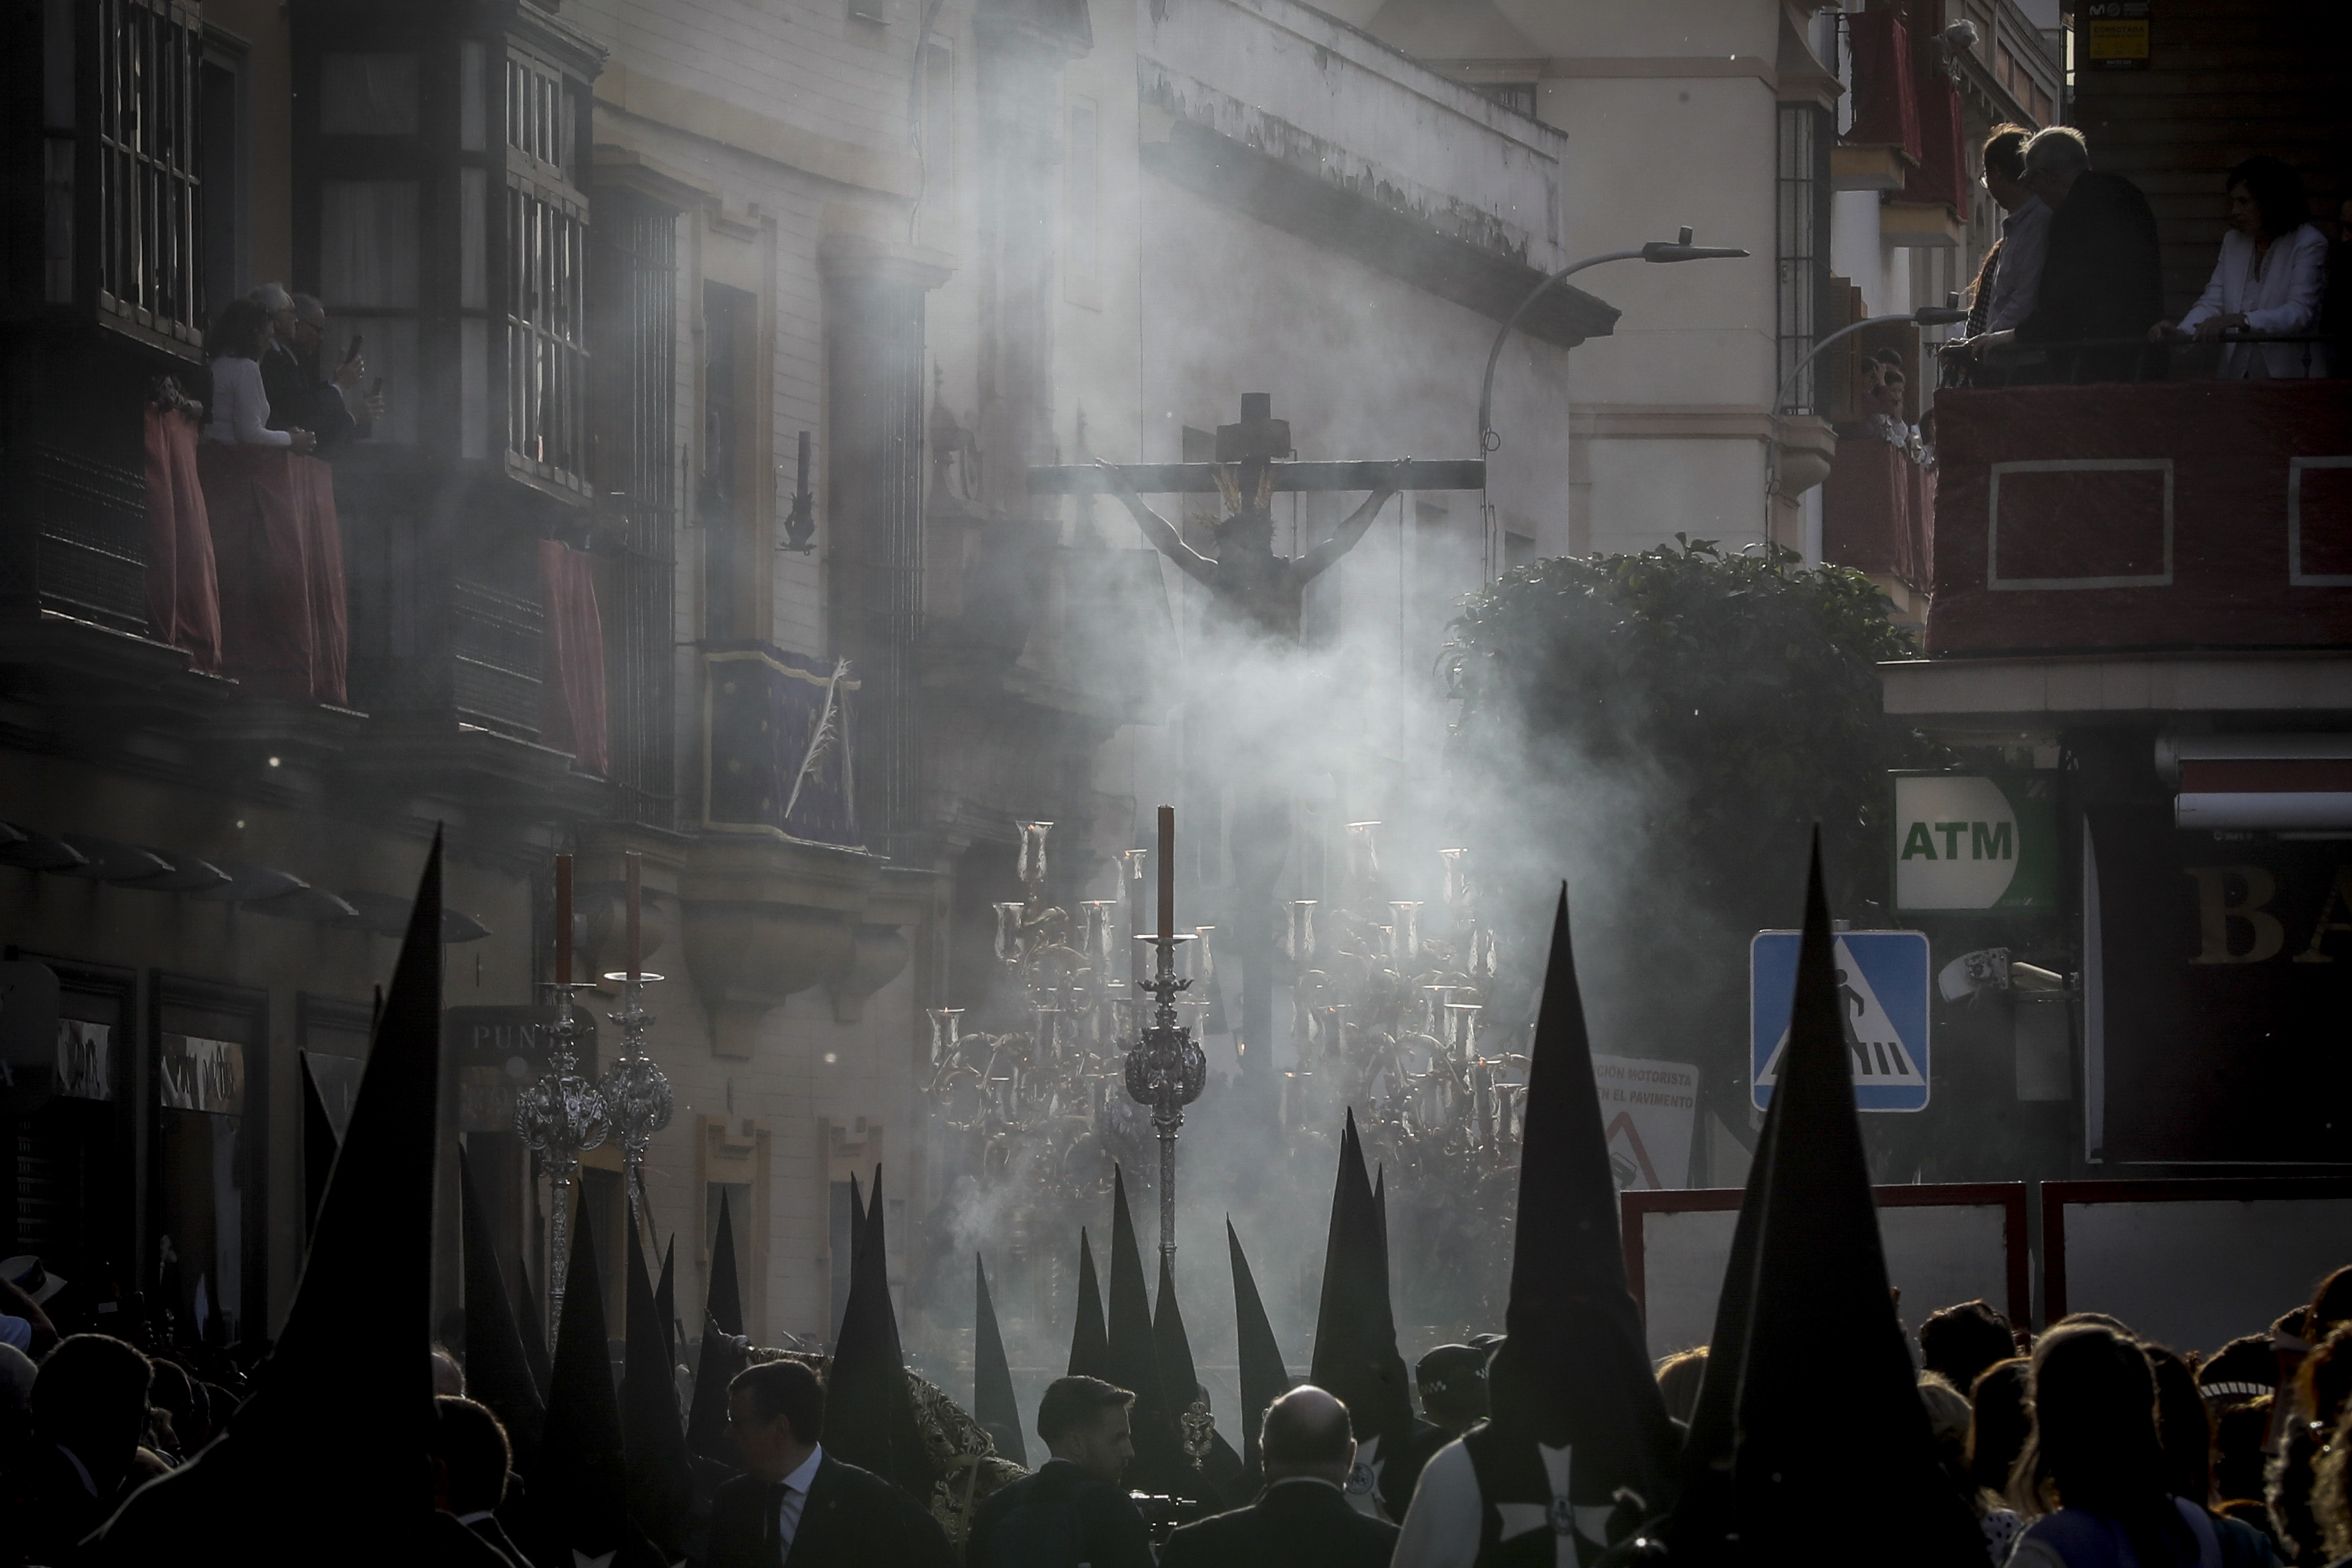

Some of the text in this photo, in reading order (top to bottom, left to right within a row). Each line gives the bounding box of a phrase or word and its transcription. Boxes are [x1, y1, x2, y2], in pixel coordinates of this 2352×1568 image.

[1901, 822, 2012, 860] ATM
[2183, 865, 2352, 964] BA
[1627, 1067, 1692, 1087] MOTORISTA
[1613, 1089, 1626, 1102] EL
[1629, 1091, 1693, 1109] PAVIMENTO
